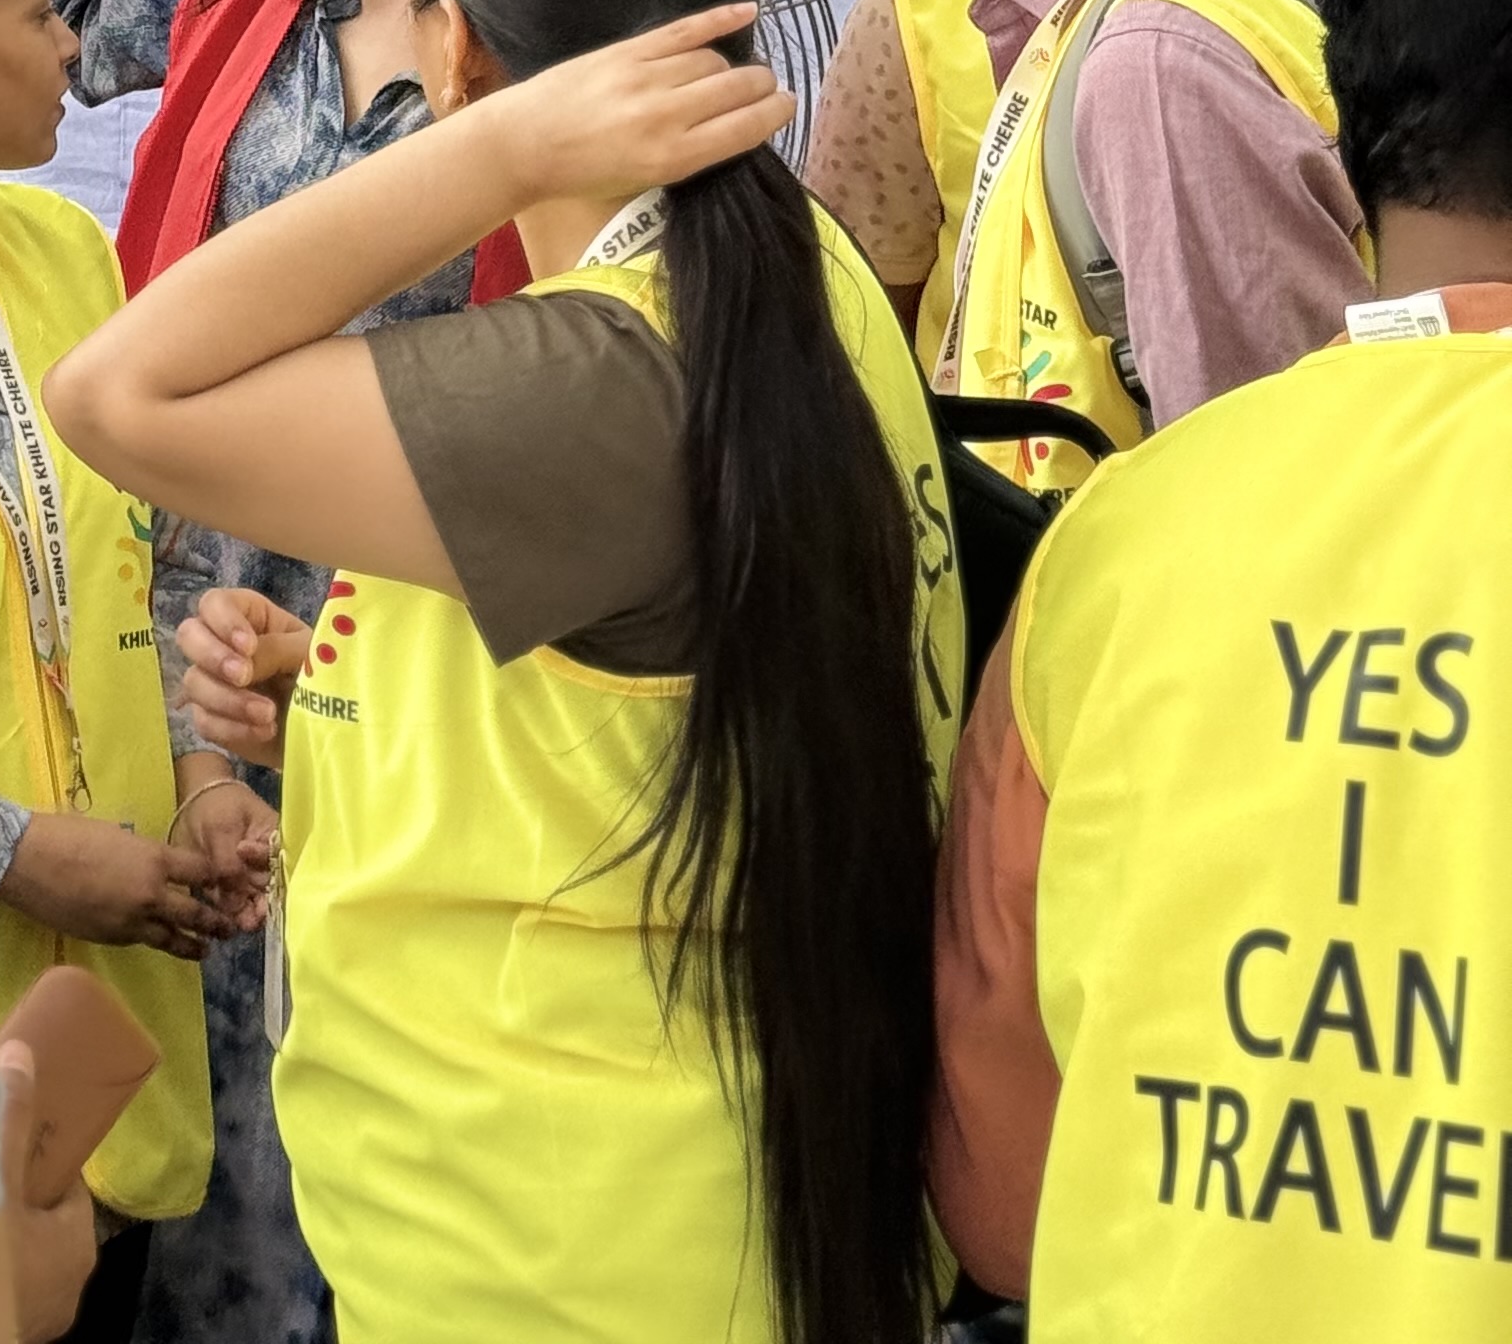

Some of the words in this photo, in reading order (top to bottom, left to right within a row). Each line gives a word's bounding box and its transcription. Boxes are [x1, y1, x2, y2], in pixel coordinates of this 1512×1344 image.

[986, 90, 1030, 168] CHEHRE
[601, 211, 658, 260] STAR
[18, 419, 49, 480] KHILTE
[38, 483, 59, 535] STAR
[18, 530, 41, 597] RISING
[49, 540, 67, 607] RISING
[1269, 617, 1475, 759] YES
[1336, 777, 1367, 908] I
[1222, 927, 1470, 1088] CAN
